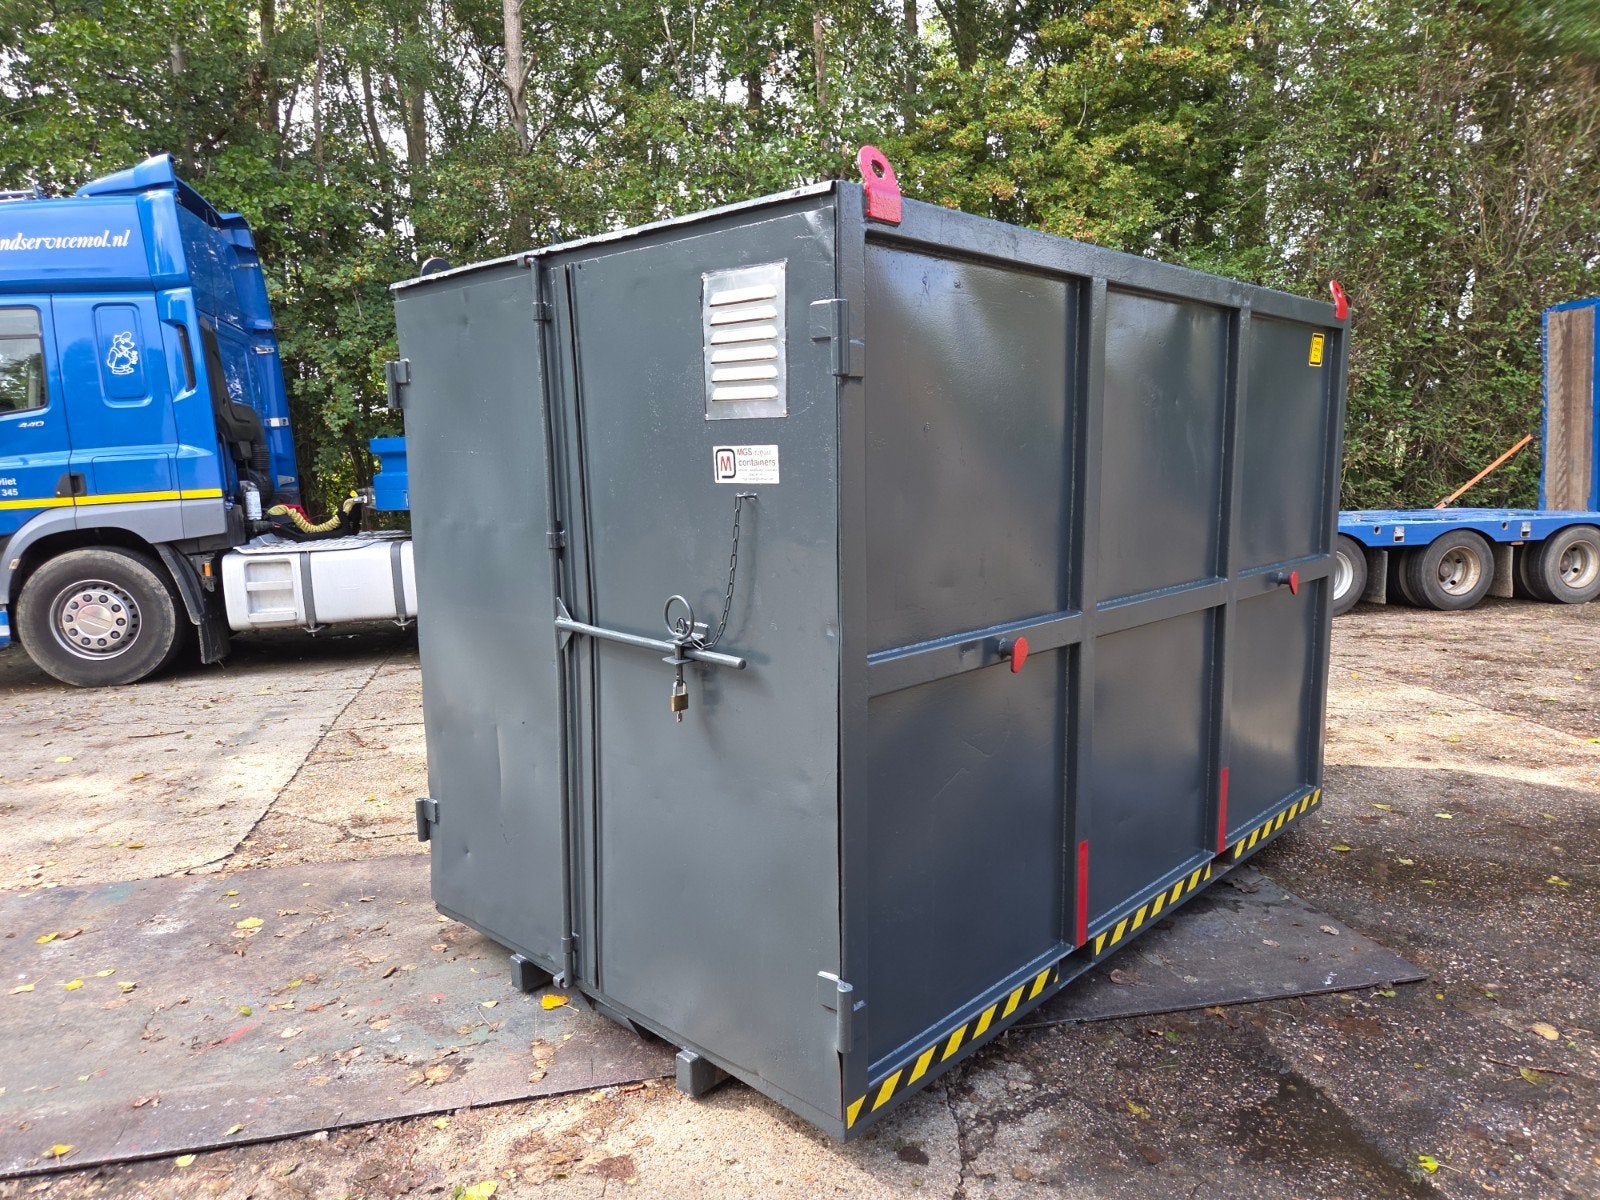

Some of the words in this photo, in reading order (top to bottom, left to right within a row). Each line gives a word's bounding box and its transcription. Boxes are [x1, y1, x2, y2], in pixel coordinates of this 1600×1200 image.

[18, 420, 45, 428] 440
[737, 448, 752, 456] MGS
[738, 458, 776, 467] containers
[1, 488, 19, 497] 345
